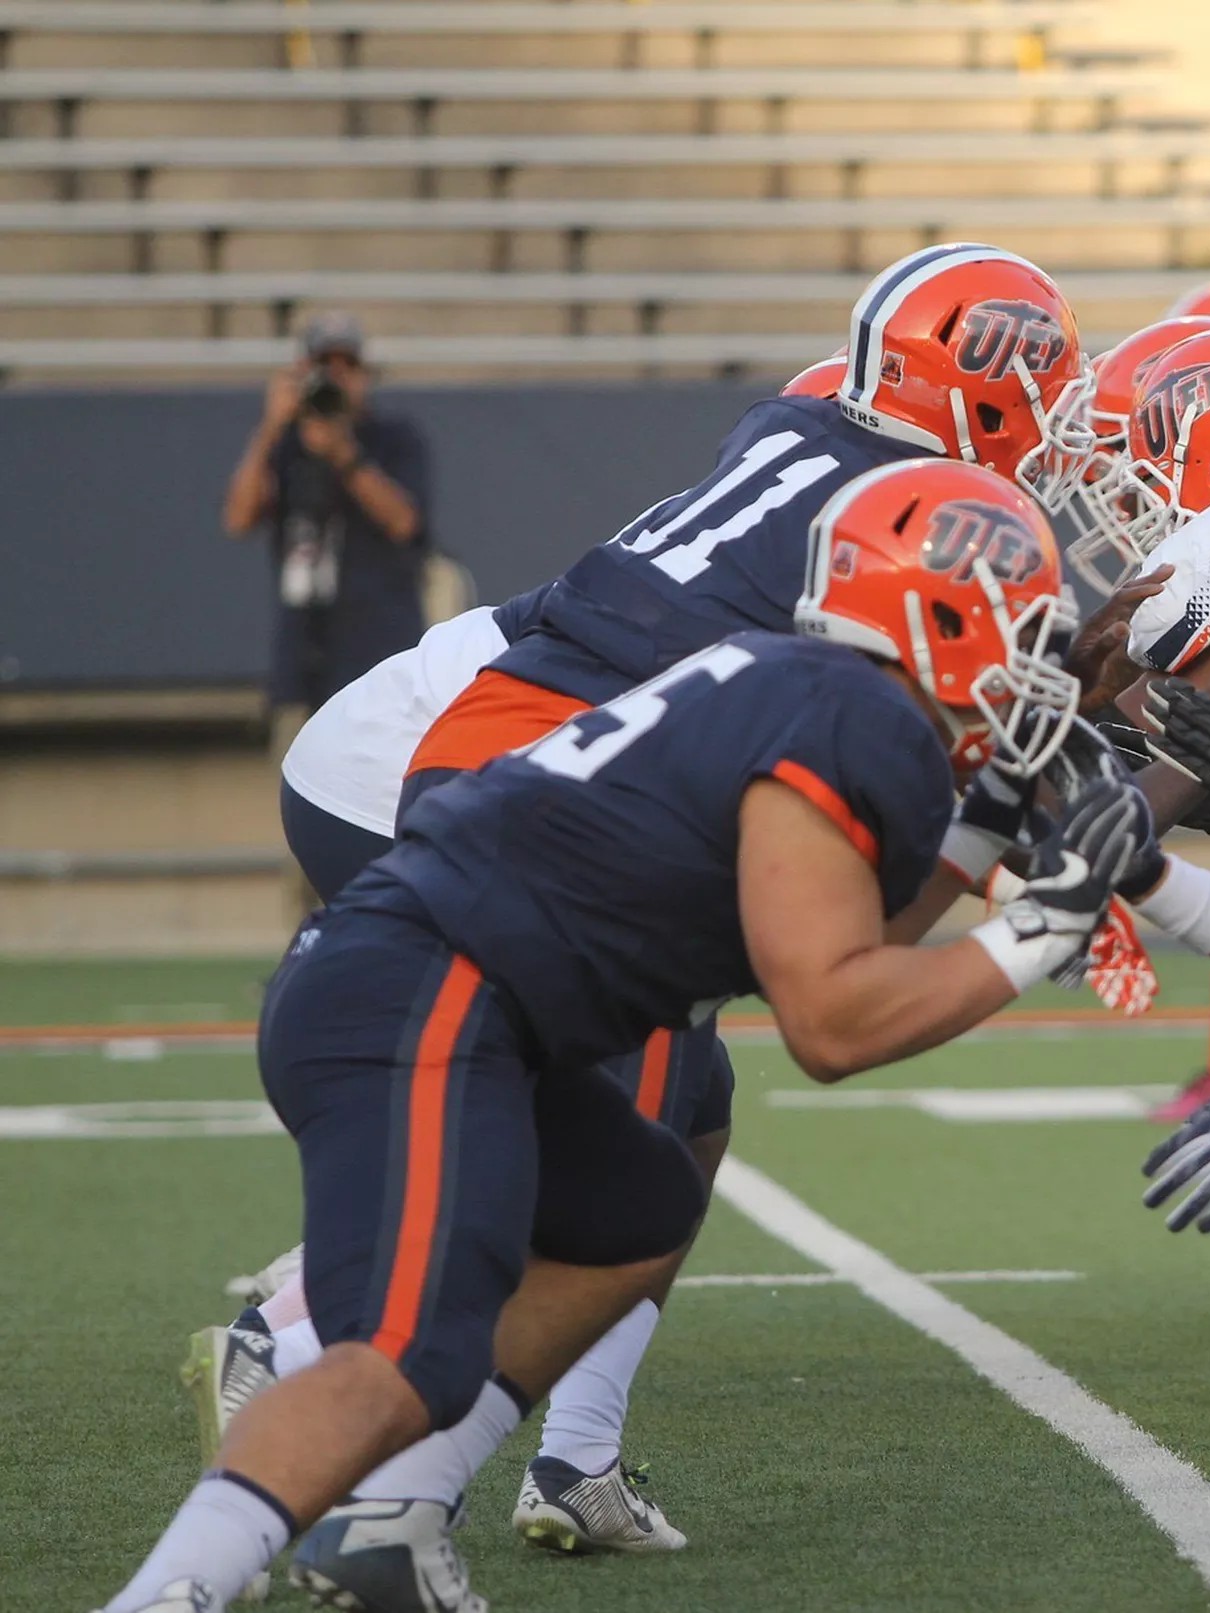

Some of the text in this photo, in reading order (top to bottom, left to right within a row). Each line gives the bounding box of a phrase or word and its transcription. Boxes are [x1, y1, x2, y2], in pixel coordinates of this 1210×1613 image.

[955, 299, 1066, 382] UTEP
[920, 499, 1042, 586] UTEP
[512, 643, 756, 782] 5
